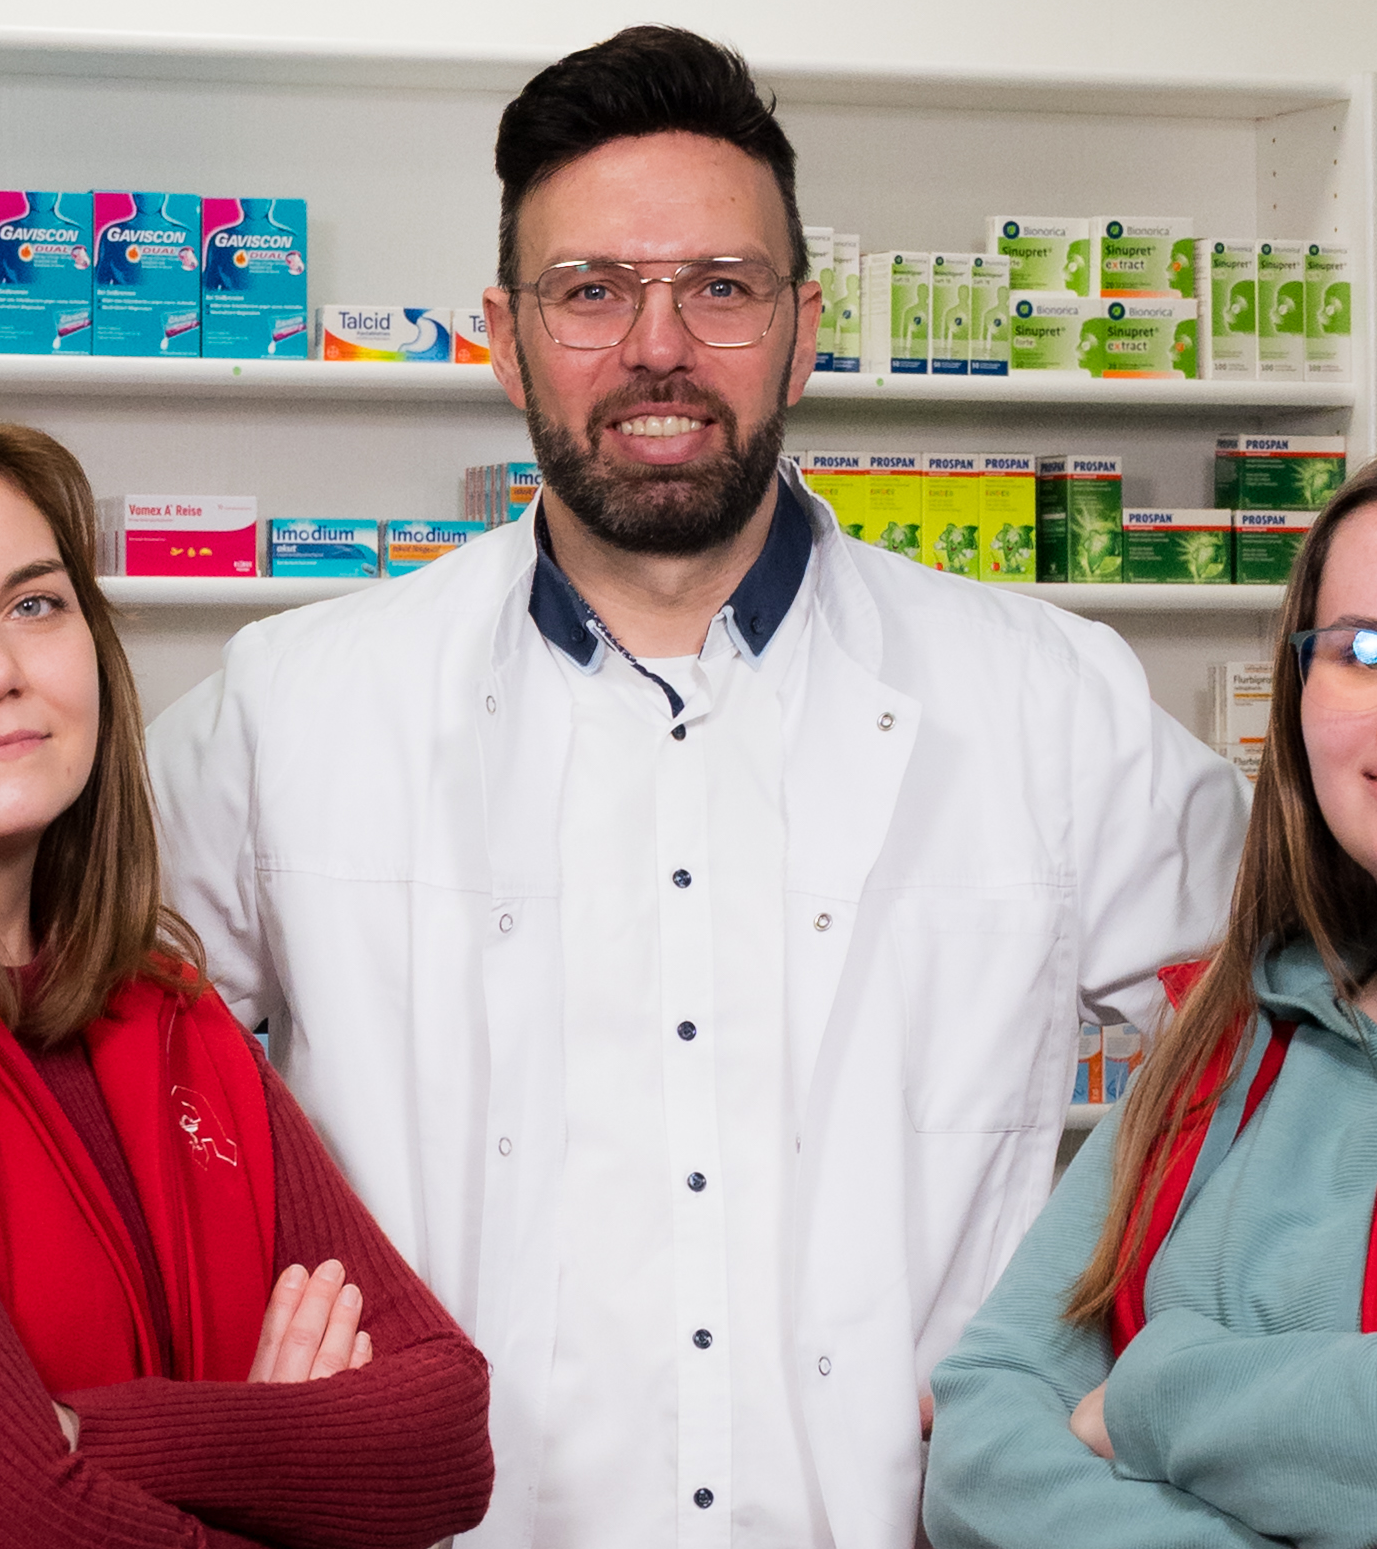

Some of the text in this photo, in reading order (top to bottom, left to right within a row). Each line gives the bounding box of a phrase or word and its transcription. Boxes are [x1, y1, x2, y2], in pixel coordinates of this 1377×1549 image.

[0, 226, 79, 242] GAVISCON
[107, 227, 186, 243] GAVISCON
[1024, 226, 1066, 237] Bionorica
[1127, 226, 1169, 237] Bionorica
[215, 232, 293, 249] GAVISCON
[1002, 246, 1047, 258] Sinupret
[1105, 245, 1151, 257] Sinupret
[1106, 260, 1144, 270] extract
[1214, 259, 1248, 270] Sinupret
[1260, 260, 1296, 271] Sinupret
[1308, 261, 1343, 271] Sinupret
[1037, 306, 1079, 316] Bionorica
[1129, 307, 1172, 317] Bionorica
[339, 312, 391, 330] Talcid
[1015, 326, 1061, 338] Sinupret
[1108, 326, 1154, 338] Sinupret
[1108, 341, 1147, 351] extract
[1246, 440, 1289, 450] PROSPAN
[813, 457, 859, 467] PROSPAN
[871, 457, 915, 468] PROSPAN
[929, 459, 973, 469] PROSPAN
[985, 459, 1029, 469] PROSPAN
[1074, 461, 1117, 471] PROSPAN
[129, 504, 202, 516] Vomex A Reise
[1129, 514, 1172, 523] PROSPAN
[1242, 515, 1285, 525] PROSPAN
[276, 526, 354, 541] Imodium
[392, 528, 467, 543] Imodium
